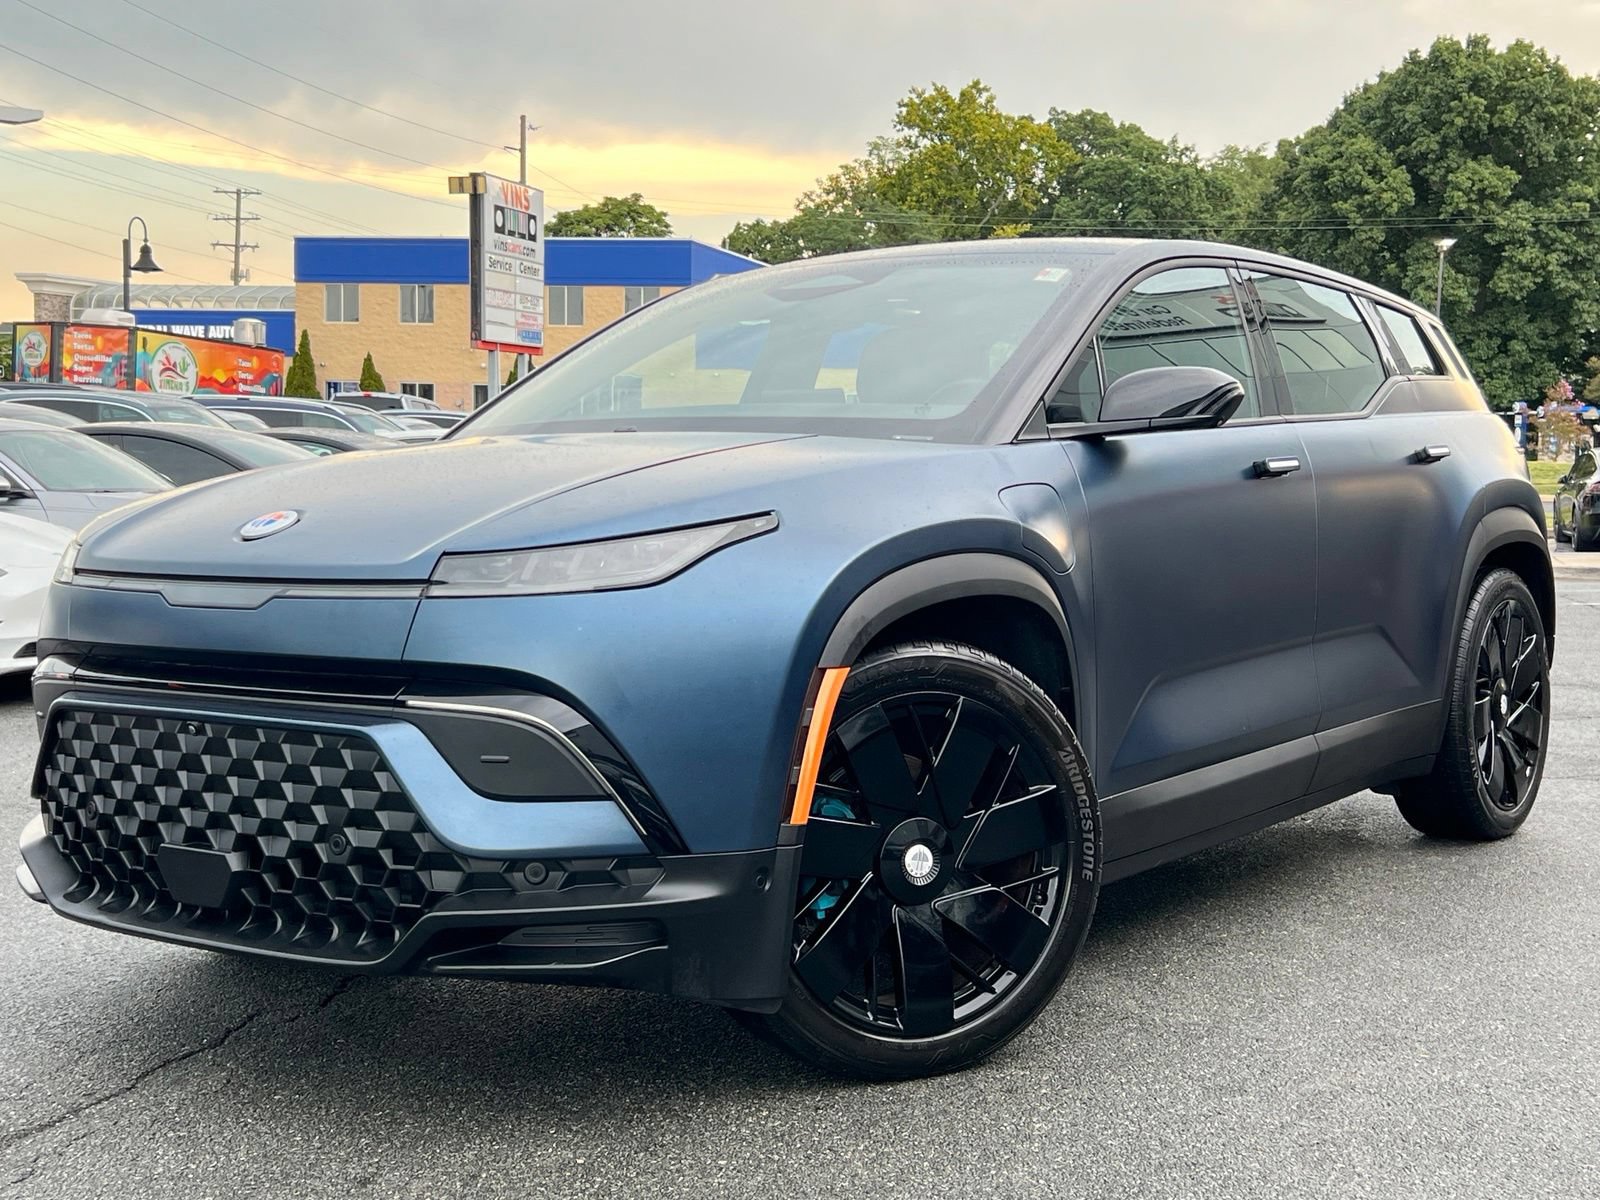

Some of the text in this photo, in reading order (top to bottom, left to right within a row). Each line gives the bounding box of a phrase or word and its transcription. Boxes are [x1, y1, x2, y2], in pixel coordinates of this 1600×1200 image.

[501, 181, 530, 212] VINS
[494, 239, 536, 259] vinscars.com
[488, 255, 540, 277] Service Center
[73, 331, 92, 340] Tacos
[171, 325, 205, 338] WAVE
[73, 342, 95, 351] Tortas
[74, 353, 113, 363] Quesadillas
[73, 374, 103, 384] Burritos
[1058, 745, 1095, 882] BRIDGESTONE
